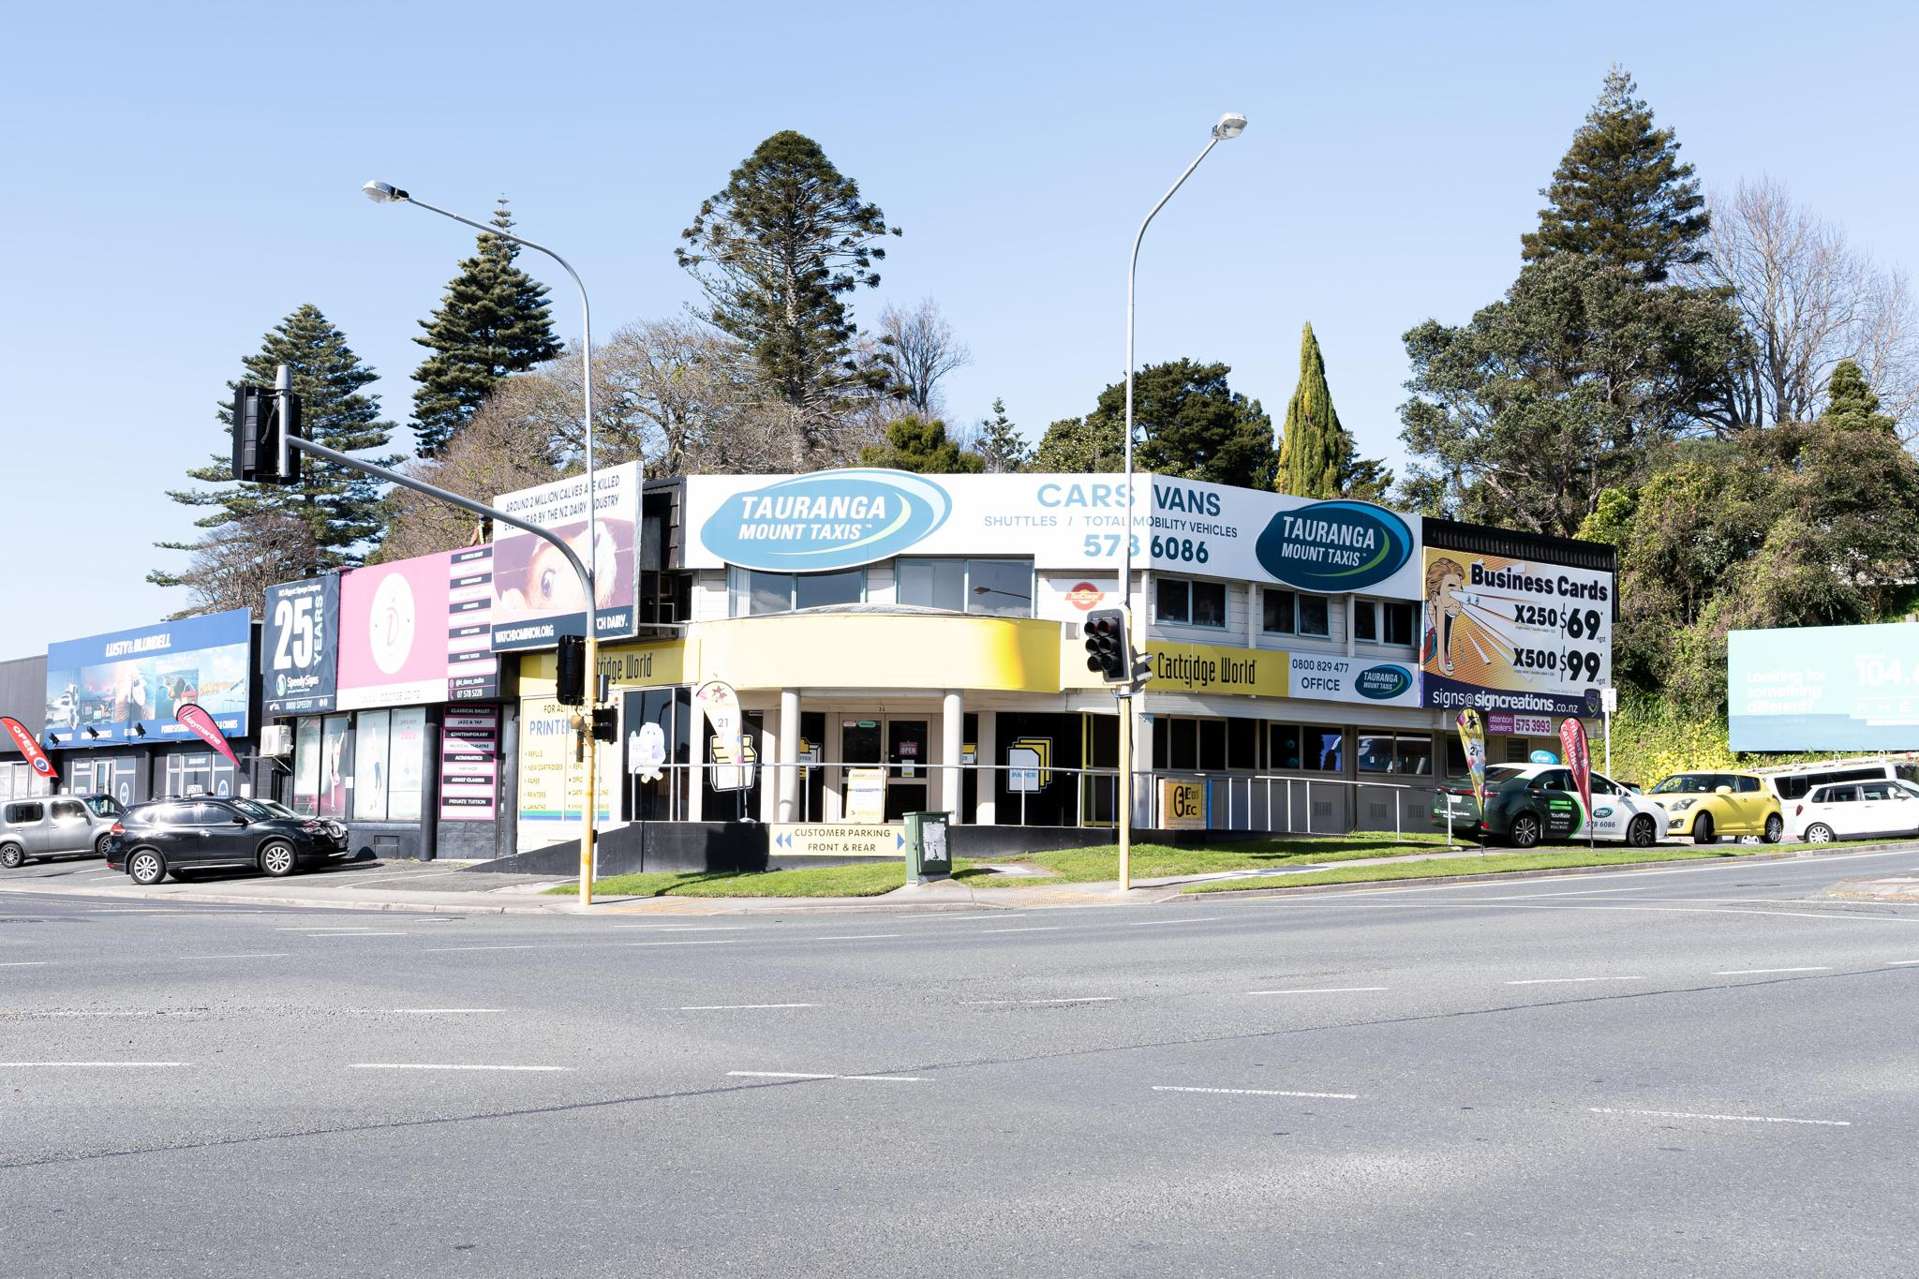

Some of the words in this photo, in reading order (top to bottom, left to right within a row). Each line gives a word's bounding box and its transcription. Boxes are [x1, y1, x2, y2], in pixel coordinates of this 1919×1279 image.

[534, 492, 558, 507] MILLION
[560, 484, 583, 500] CALVES
[584, 480, 596, 495] AE
[598, 474, 620, 490] KILLED
[1037, 483, 1136, 508] CARS
[1153, 484, 1221, 517] VANS
[548, 510, 558, 520] THE
[560, 506, 568, 518] NZ
[592, 494, 619, 510] NDUSTRY
[742, 496, 886, 519] TAURANGA
[738, 524, 806, 540] MOUNT
[810, 524, 862, 540] TAXIS
[984, 516, 1058, 526] SHUTTLES
[1133, 516, 1187, 531] MOBILITY
[1189, 520, 1238, 538] VEHICLES
[1283, 516, 1375, 550] TAURANGA
[1150, 535, 1210, 564] 6086
[1281, 542, 1326, 562] MOUNT
[1328, 549, 1360, 567] TAXIS
[1471, 563, 1554, 594] Business
[1557, 575, 1608, 602] Cards
[1514, 604, 1558, 627] X250
[273, 596, 313, 670] 25
[313, 594, 324, 666] YEARS
[596, 656, 622, 684] tridge
[626, 652, 653, 679] World
[1221, 656, 1256, 684] World
[1292, 658, 1316, 671] 0800
[1316, 660, 1332, 672] 829
[1334, 662, 1350, 674] 477
[1513, 648, 1556, 670] X500
[1301, 676, 1341, 692] OFFICE
[1364, 671, 1398, 683] TAURANGA
[544, 704, 556, 714] FOR
[1432, 688, 1578, 714] signs@signcreations.co.nz
[718, 718, 729, 728] 21
[1516, 719, 1530, 731] 575
[1532, 719, 1550, 733] 3993
[12, 725, 38, 756] OPEN
[794, 829, 846, 837] CUSTOMER
[848, 829, 891, 838] PARKING
[808, 843, 839, 852] FRONT
[842, 843, 850, 852] &
[852, 843, 876, 852] REAR
